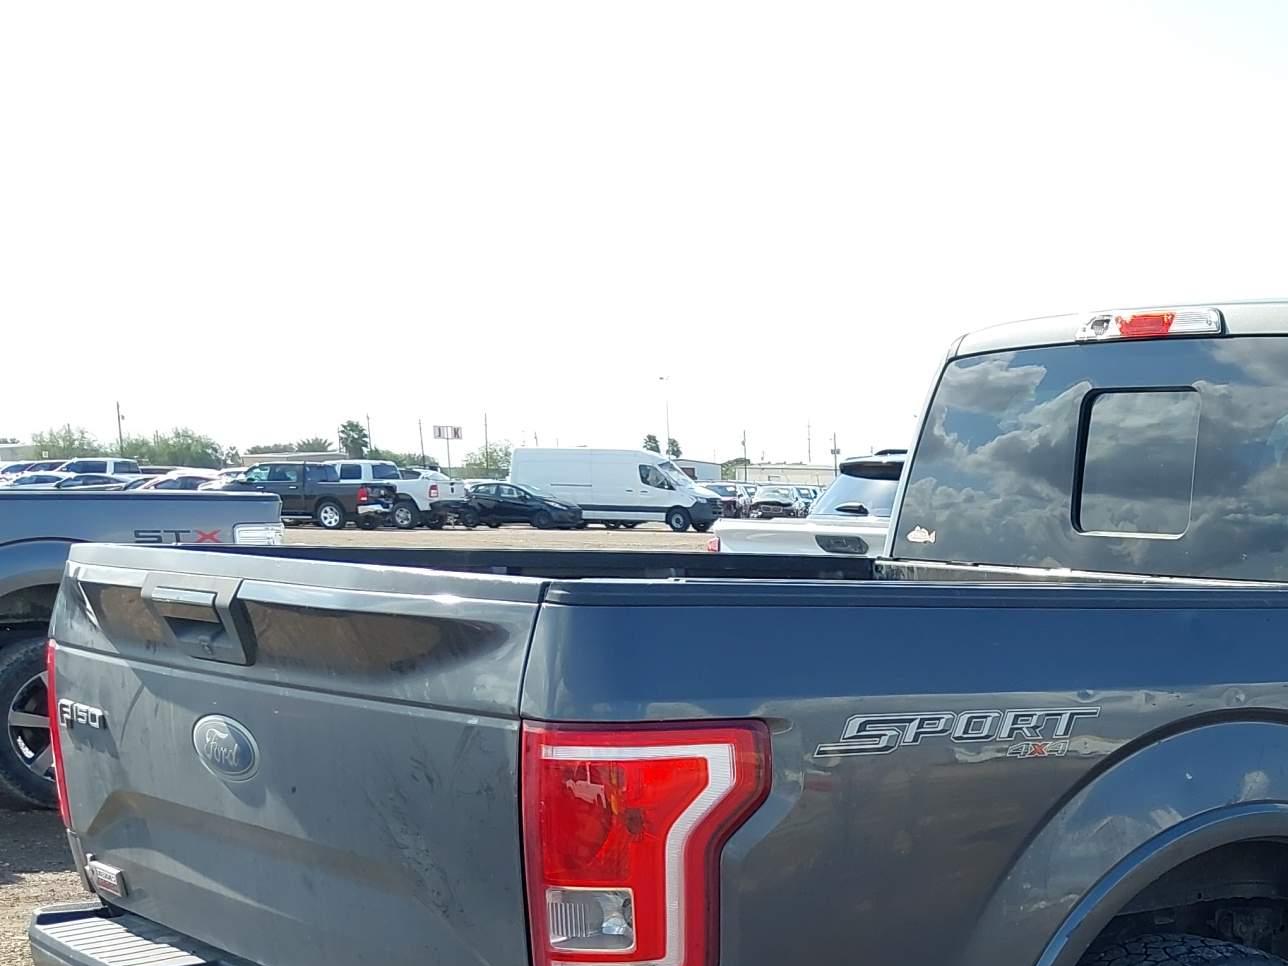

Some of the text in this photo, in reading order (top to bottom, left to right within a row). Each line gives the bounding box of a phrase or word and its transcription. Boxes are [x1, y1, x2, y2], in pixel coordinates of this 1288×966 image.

[134, 529, 224, 544] STX
[58, 698, 104, 730] F150
[813, 706, 1102, 758] SPORT
[203, 727, 241, 768] Ford
